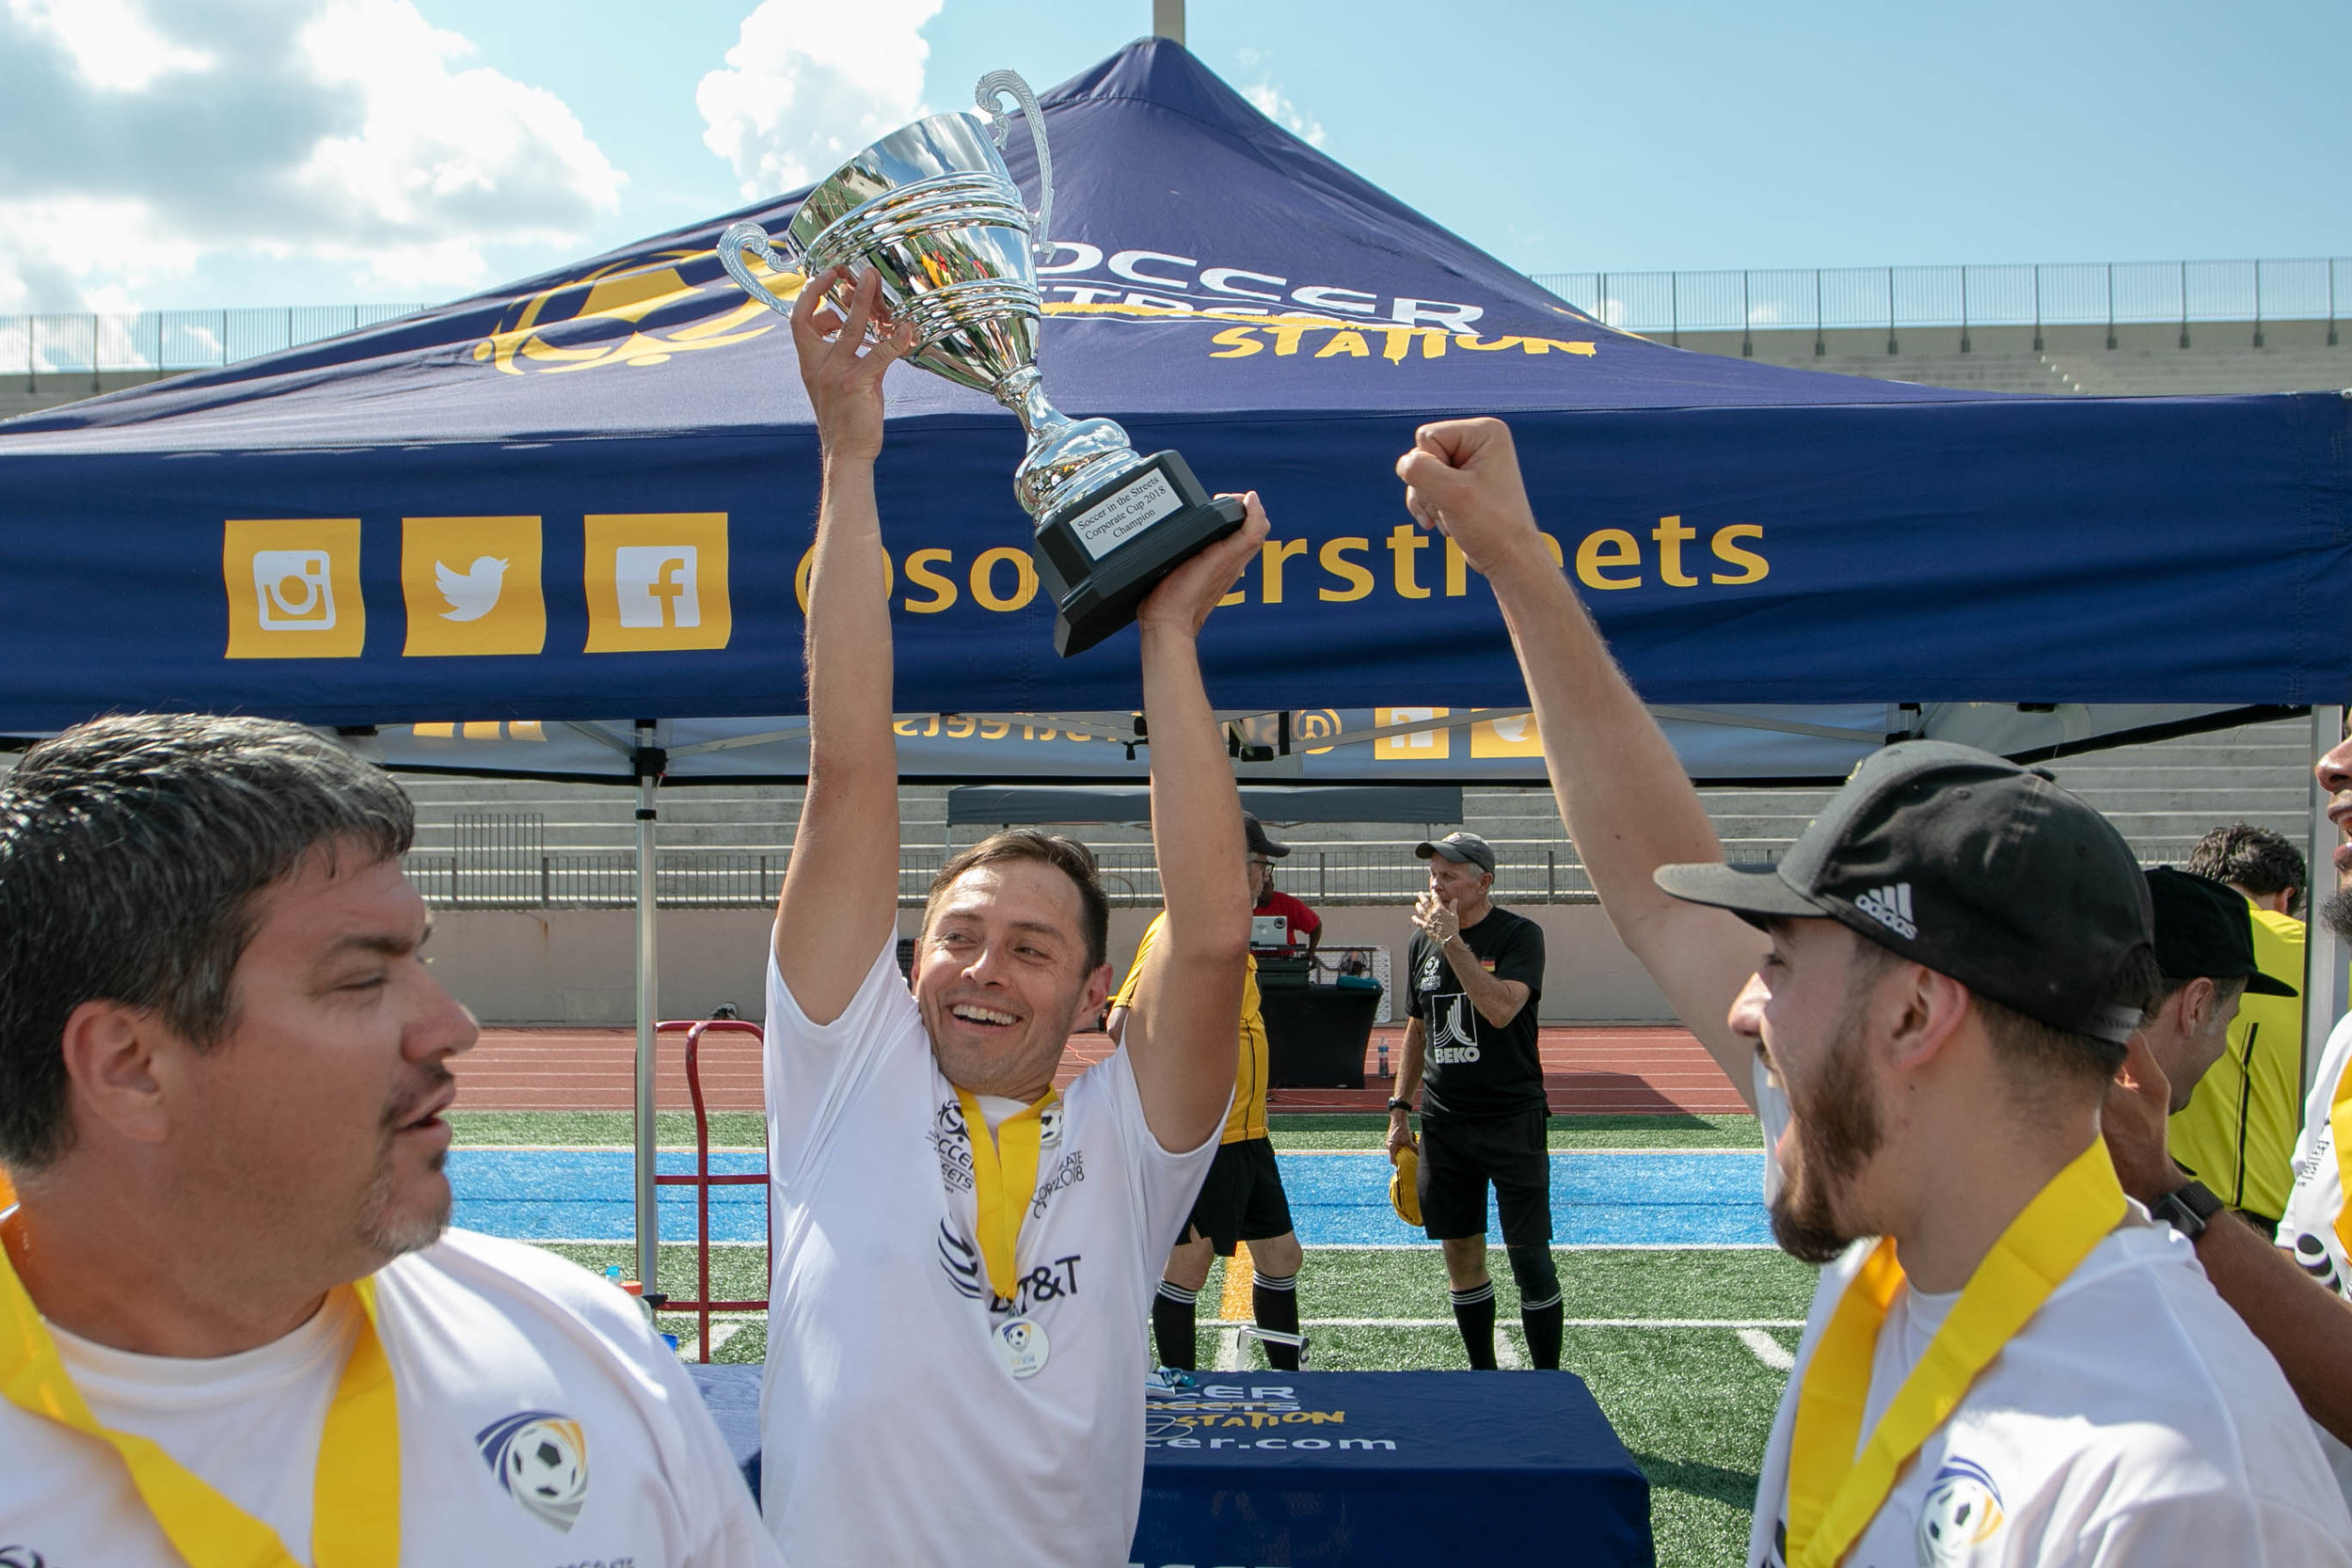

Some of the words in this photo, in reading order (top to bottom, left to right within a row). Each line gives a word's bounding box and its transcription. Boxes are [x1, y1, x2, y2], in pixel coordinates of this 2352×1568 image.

[1033, 242, 1484, 334] OCCER
[1077, 510, 1106, 530] Soccer
[1107, 504, 1118, 513] in
[1117, 496, 1131, 509] the
[1130, 476, 1160, 497] Streets
[1085, 512, 1126, 540] Corporate
[1126, 500, 1145, 517] Cup
[1144, 485, 1167, 503] 2018
[1113, 508, 1156, 538] Champion
[1855, 894, 1918, 940] adidas
[1435, 1046, 1480, 1064] BEKO
[1176, 1411, 1344, 1430] STATION
